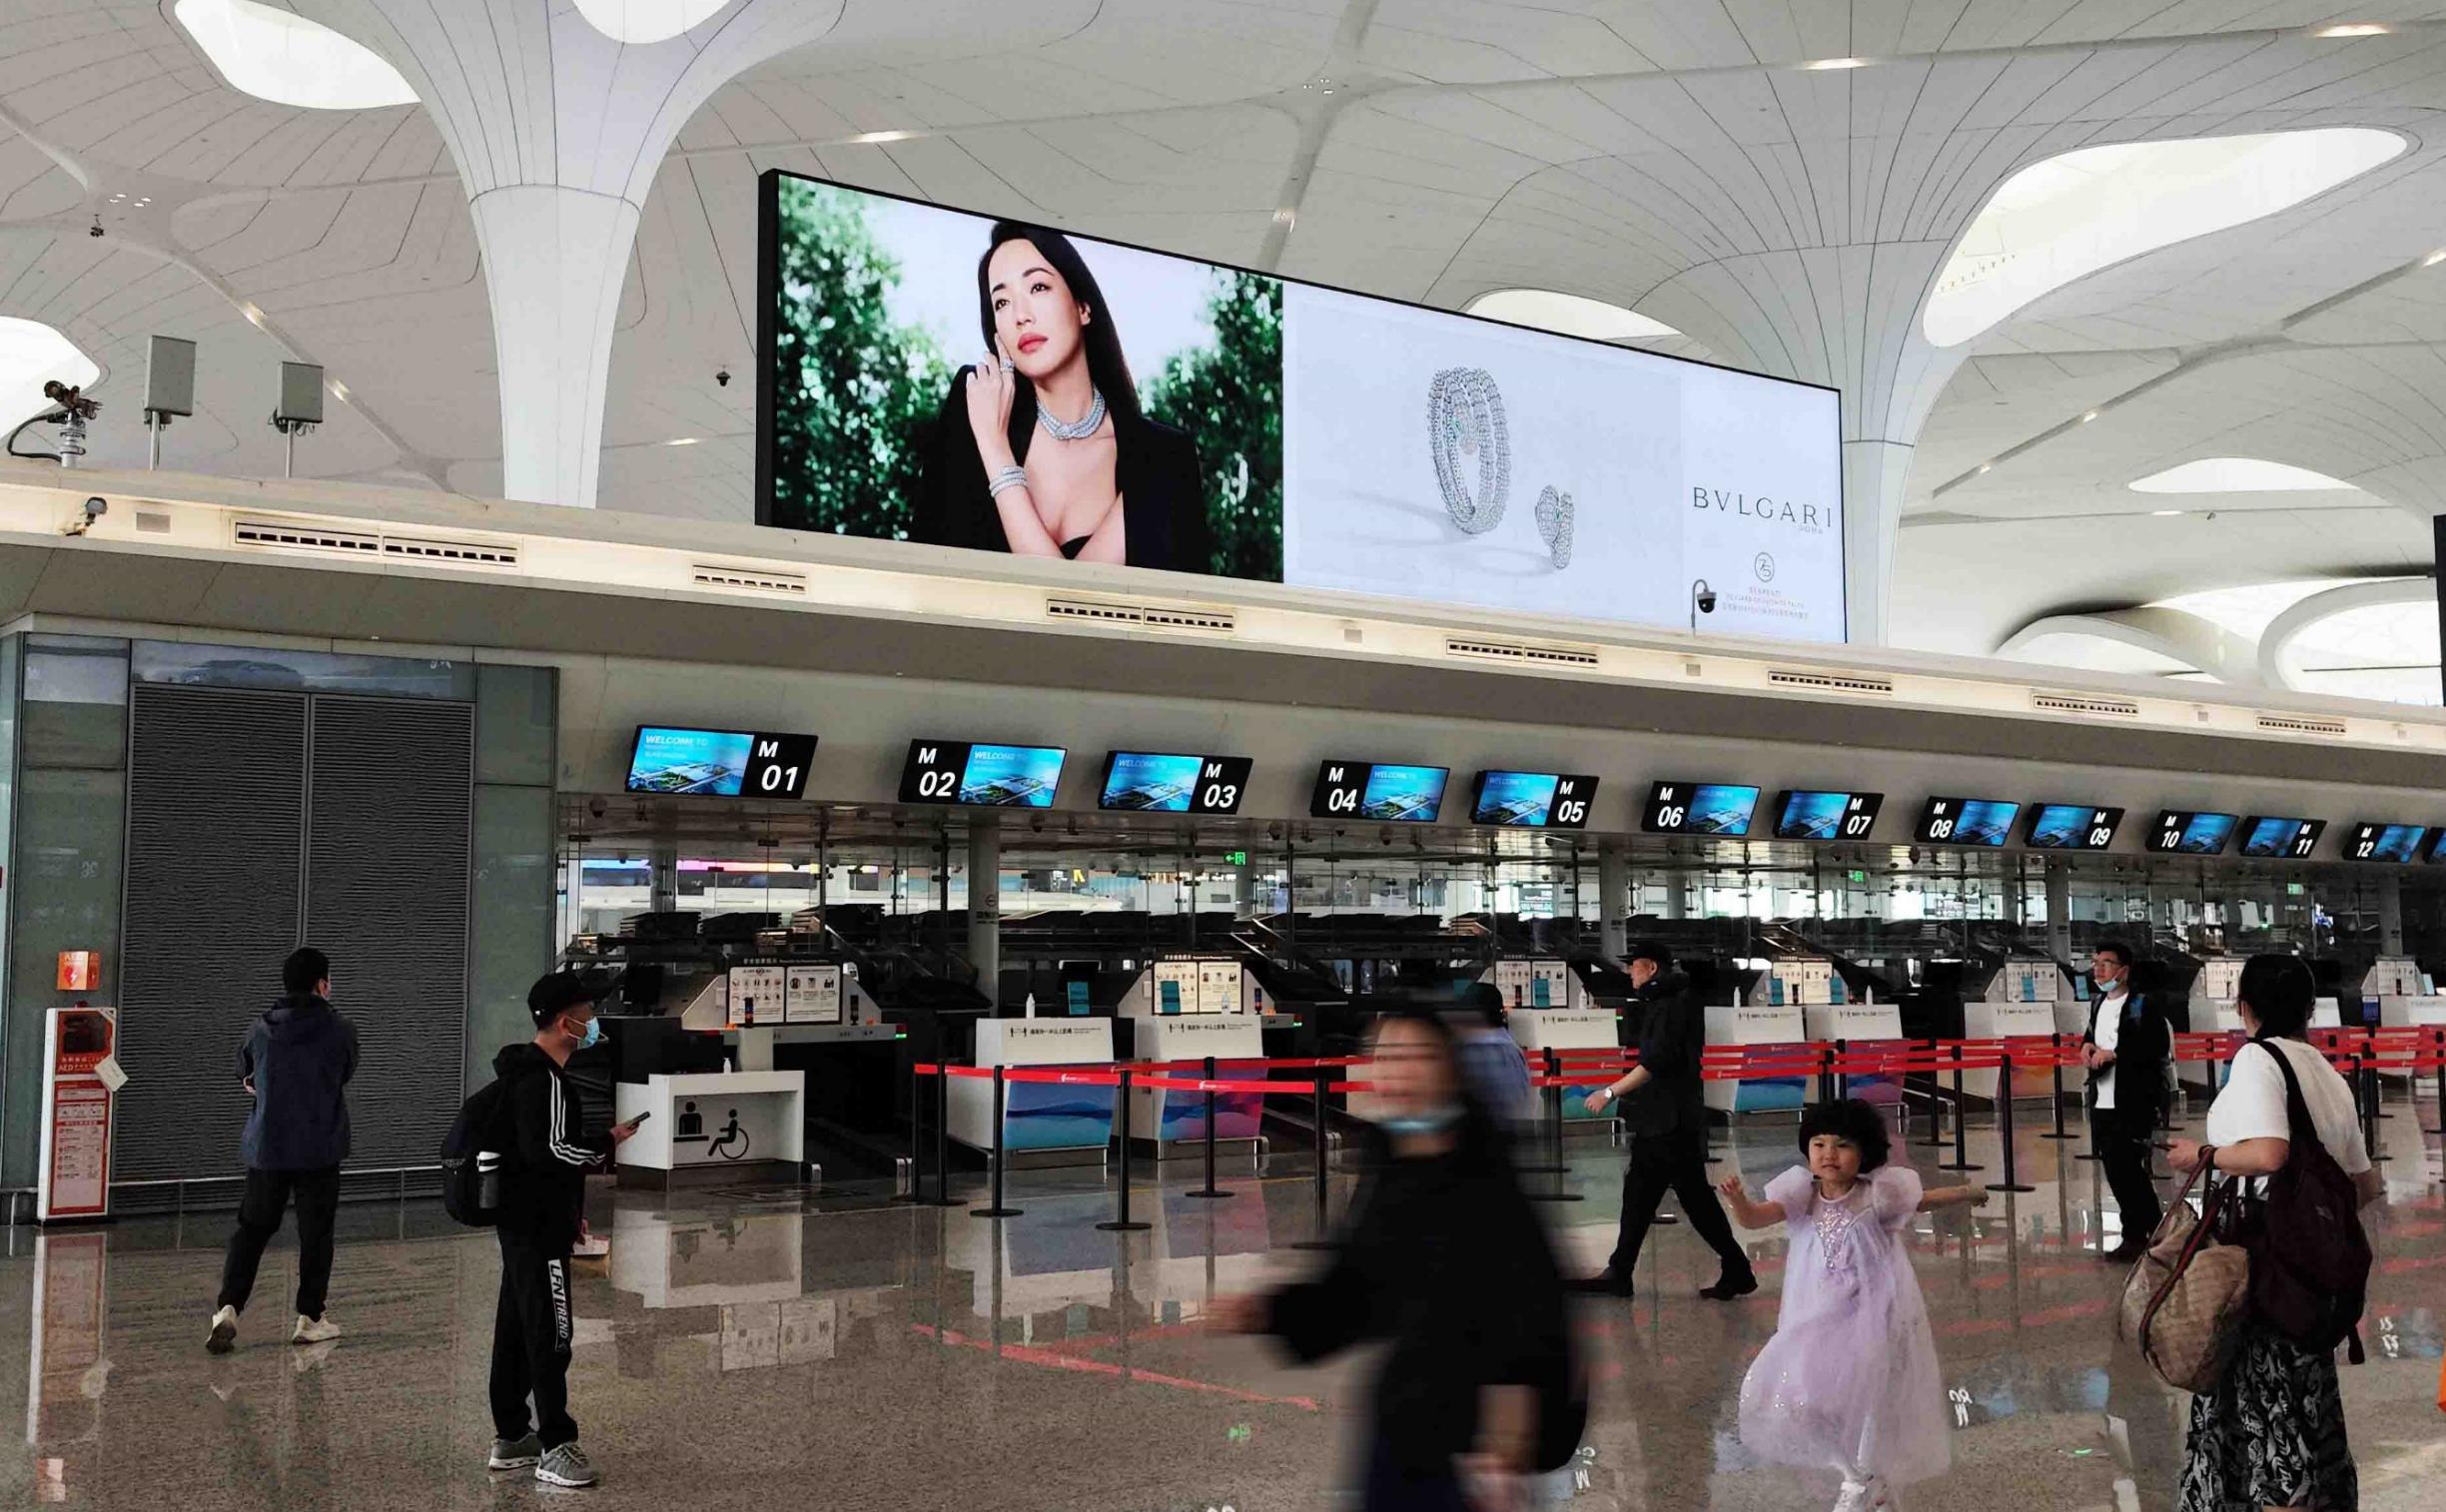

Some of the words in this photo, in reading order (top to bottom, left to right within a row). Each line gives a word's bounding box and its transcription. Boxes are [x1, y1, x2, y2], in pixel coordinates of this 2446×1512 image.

[1693, 486, 1831, 527] BVLGARI
[759, 741, 778, 757] M
[919, 748, 937, 763] M
[762, 765, 798, 791] 01
[1206, 763, 1222, 778] M
[1328, 767, 1344, 782] M
[920, 771, 955, 796] 02
[1559, 781, 1574, 795] M
[1205, 784, 1236, 808] 03
[1328, 788, 1357, 812] 04
[1659, 787, 1673, 801] M
[1558, 800, 1586, 823] 05
[1850, 798, 1863, 811] M
[1934, 802, 1947, 815] M
[1658, 806, 1684, 828] 06
[1847, 815, 1872, 835] 07
[2093, 811, 2106, 824] M
[2164, 815, 2177, 827] M
[1930, 819, 1953, 838] 08
[2299, 823, 2312, 835] M
[2360, 827, 2372, 838] M
[2089, 828, 2111, 846] 09
[2161, 831, 2180, 848] 10
[2295, 839, 2313, 855] 11
[2356, 841, 2374, 858] 12
[556, 1300, 568, 1339] TREND
